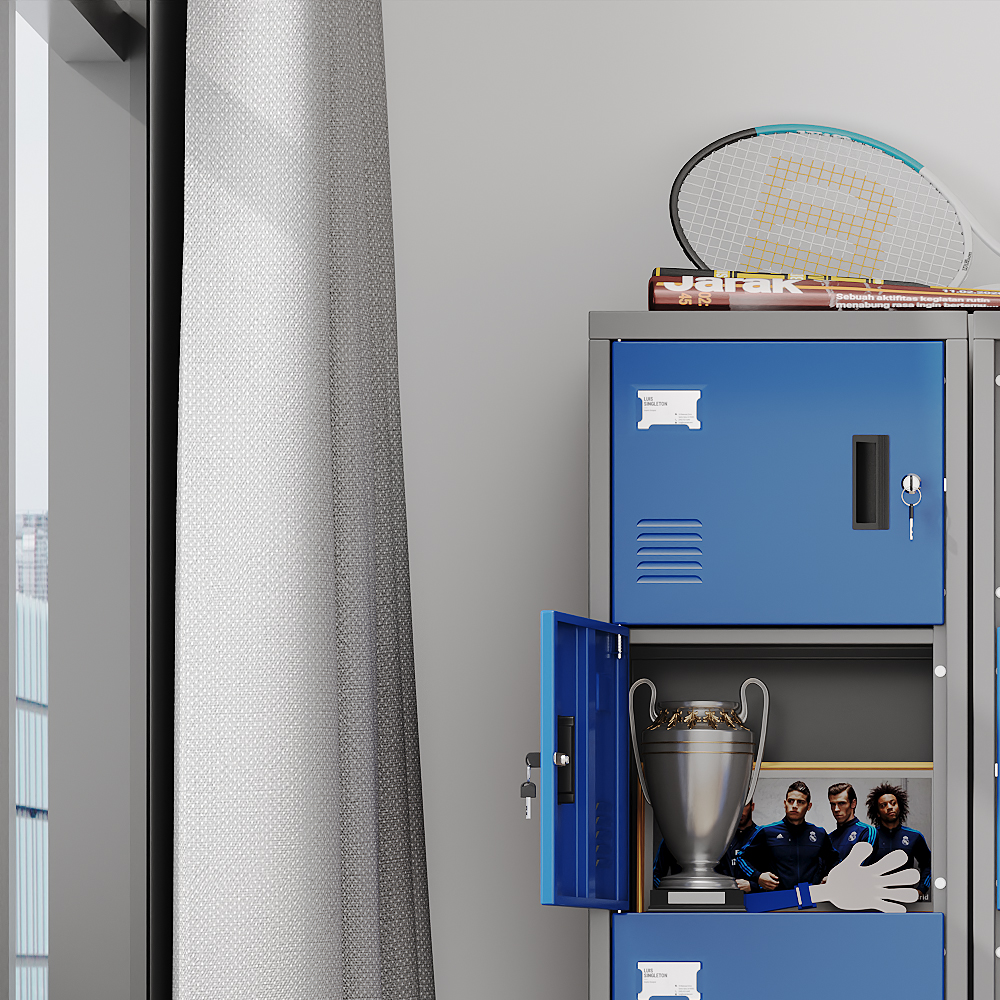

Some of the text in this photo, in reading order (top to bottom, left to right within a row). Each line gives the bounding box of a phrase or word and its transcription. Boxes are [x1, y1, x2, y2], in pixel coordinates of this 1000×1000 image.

[664, 276, 803, 294] Jarak
[678, 292, 693, 306] 45
[836, 293, 874, 301] Sebuah
[877, 294, 919, 302] aktifitas
[836, 301, 890, 309] menabung
